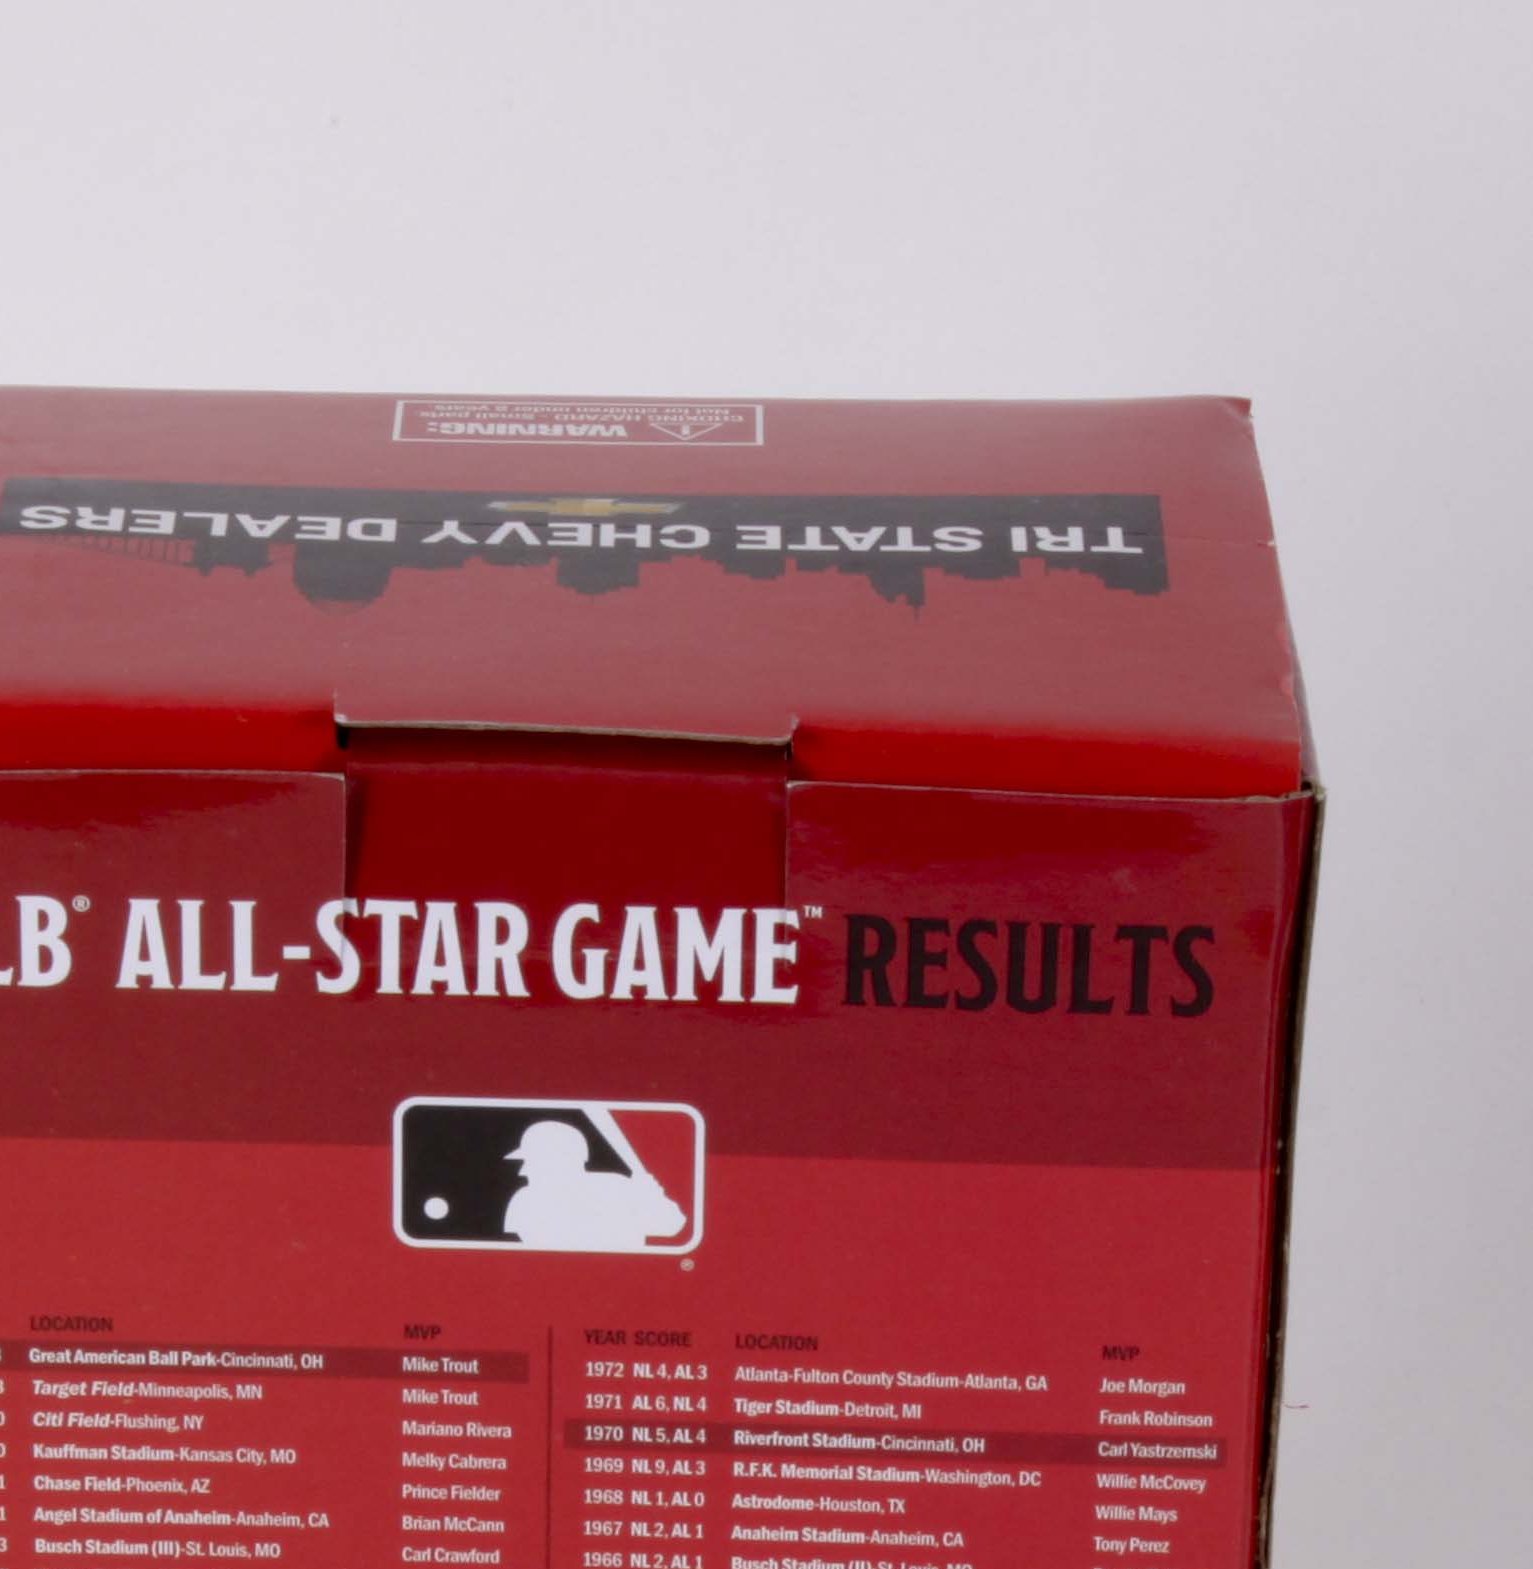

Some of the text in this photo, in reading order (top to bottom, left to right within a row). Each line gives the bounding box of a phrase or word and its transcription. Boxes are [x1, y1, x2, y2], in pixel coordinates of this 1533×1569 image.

[19, 504, 1143, 554] TRI STATE CHEVY DEALERS
[115, 897, 531, 998] ALL-STAR
[842, 913, 1216, 1018] RESULTS
[29, 1315, 113, 1333] LOCATION
[403, 1324, 442, 1340] MVP
[584, 1329, 627, 1345] YEAR
[633, 1329, 691, 1348] SCORE
[734, 1333, 819, 1352] LOCATION
[28, 1347, 72, 1364] Great
[70, 1348, 147, 1366] American
[147, 1349, 180, 1367] Ball
[300, 1353, 324, 1370] OH
[1101, 1344, 1141, 1361] MVP
[401, 1355, 480, 1375] Mike Trout
[585, 1360, 625, 1379] 1972
[841, 1368, 895, 1390] County
[1024, 1374, 1048, 1391] GA
[1099, 1377, 1186, 1398] Joe Morgan
[32, 1411, 65, 1428] Citi
[182, 1414, 205, 1431] NY
[401, 1419, 513, 1439] Mariano Rivera
[585, 1424, 625, 1442] 1970
[733, 1429, 811, 1448] Riverfront
[961, 1437, 986, 1453] OH
[1097, 1440, 1218, 1460] Carl Yastrzemski
[34, 1537, 84, 1555] Busch
[84, 1538, 150, 1556] Stadium
[254, 1542, 282, 1559] MO
[401, 1545, 501, 1565] Carl Crawford
